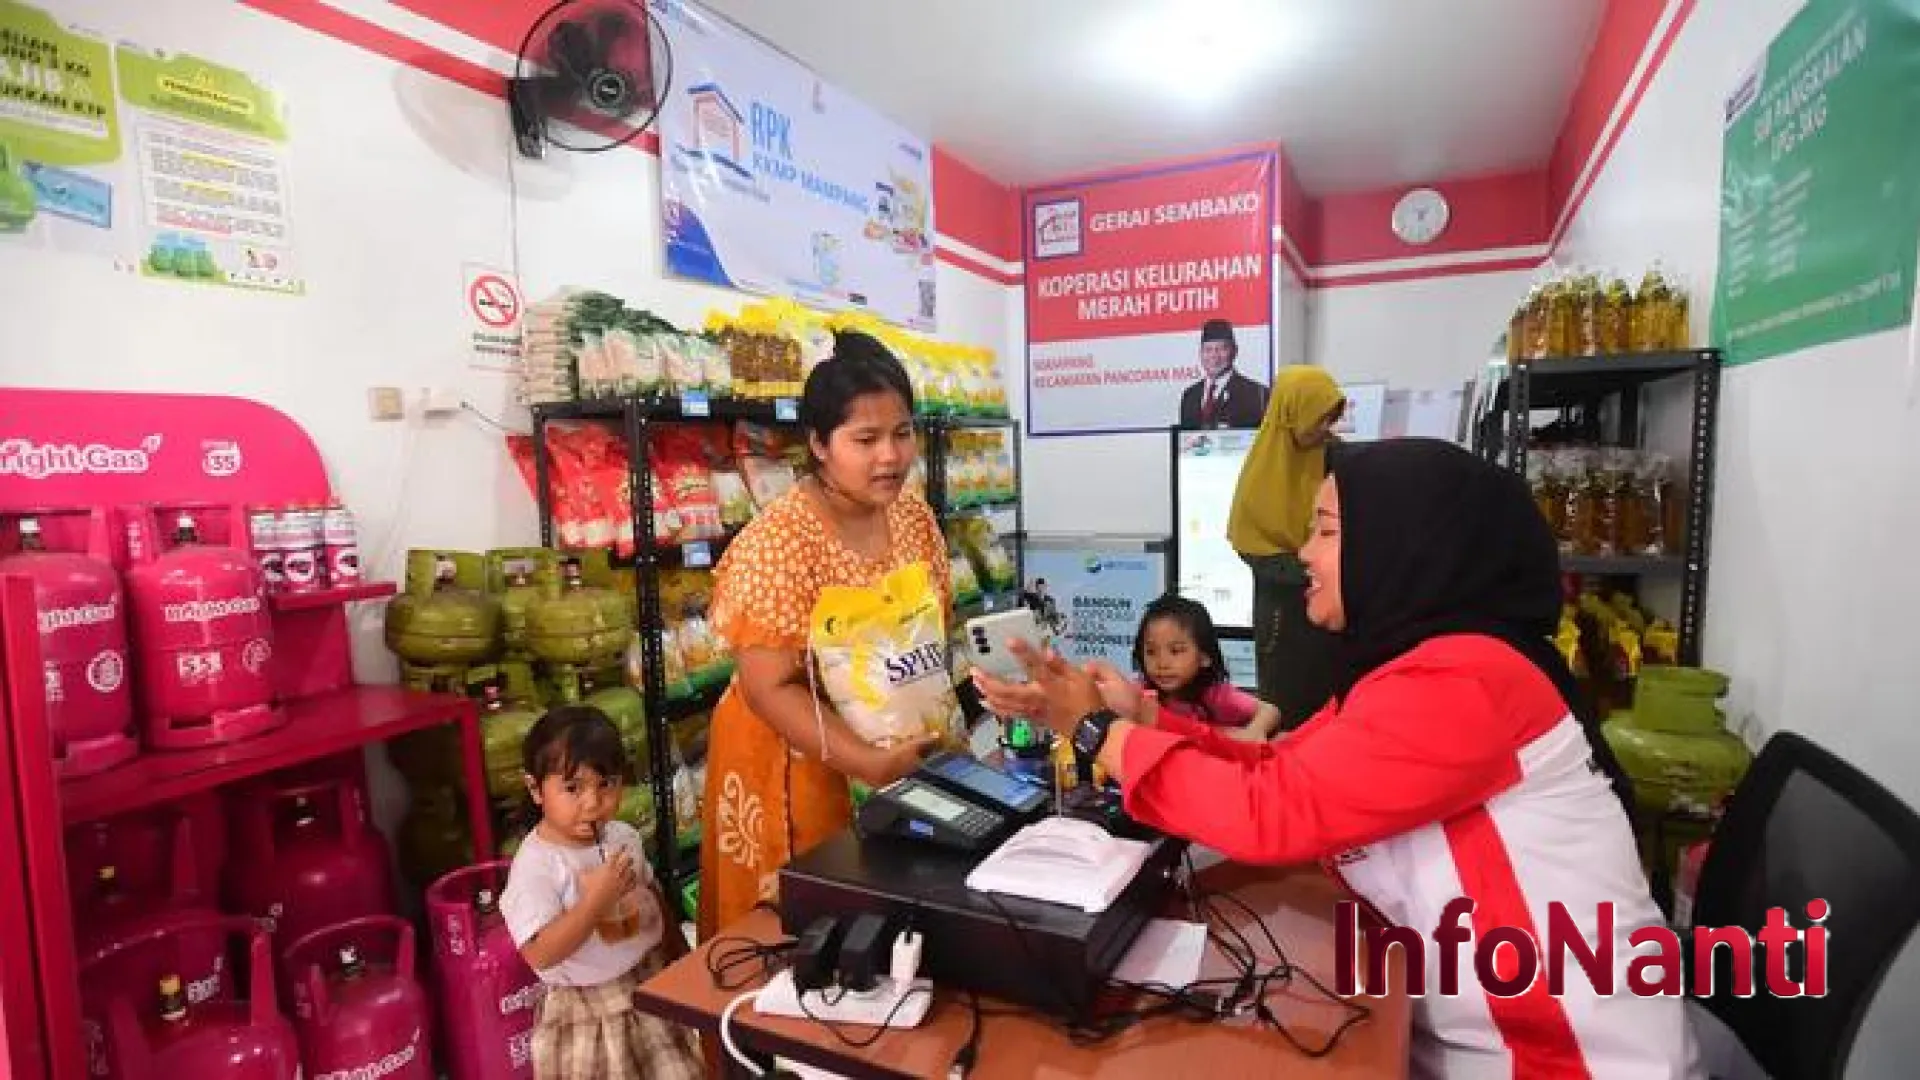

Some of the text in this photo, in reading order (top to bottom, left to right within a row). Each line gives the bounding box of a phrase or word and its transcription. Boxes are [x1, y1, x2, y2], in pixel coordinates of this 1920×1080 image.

[752, 101, 793, 161] RPK
[1089, 209, 1150, 232] GERAI
[1154, 192, 1260, 224] SEMBAKO
[1038, 253, 1262, 298] KOPERASI KELURAHAN
[1078, 287, 1219, 320] MERAH PUTIH
[84, 444, 149, 474] Gas
